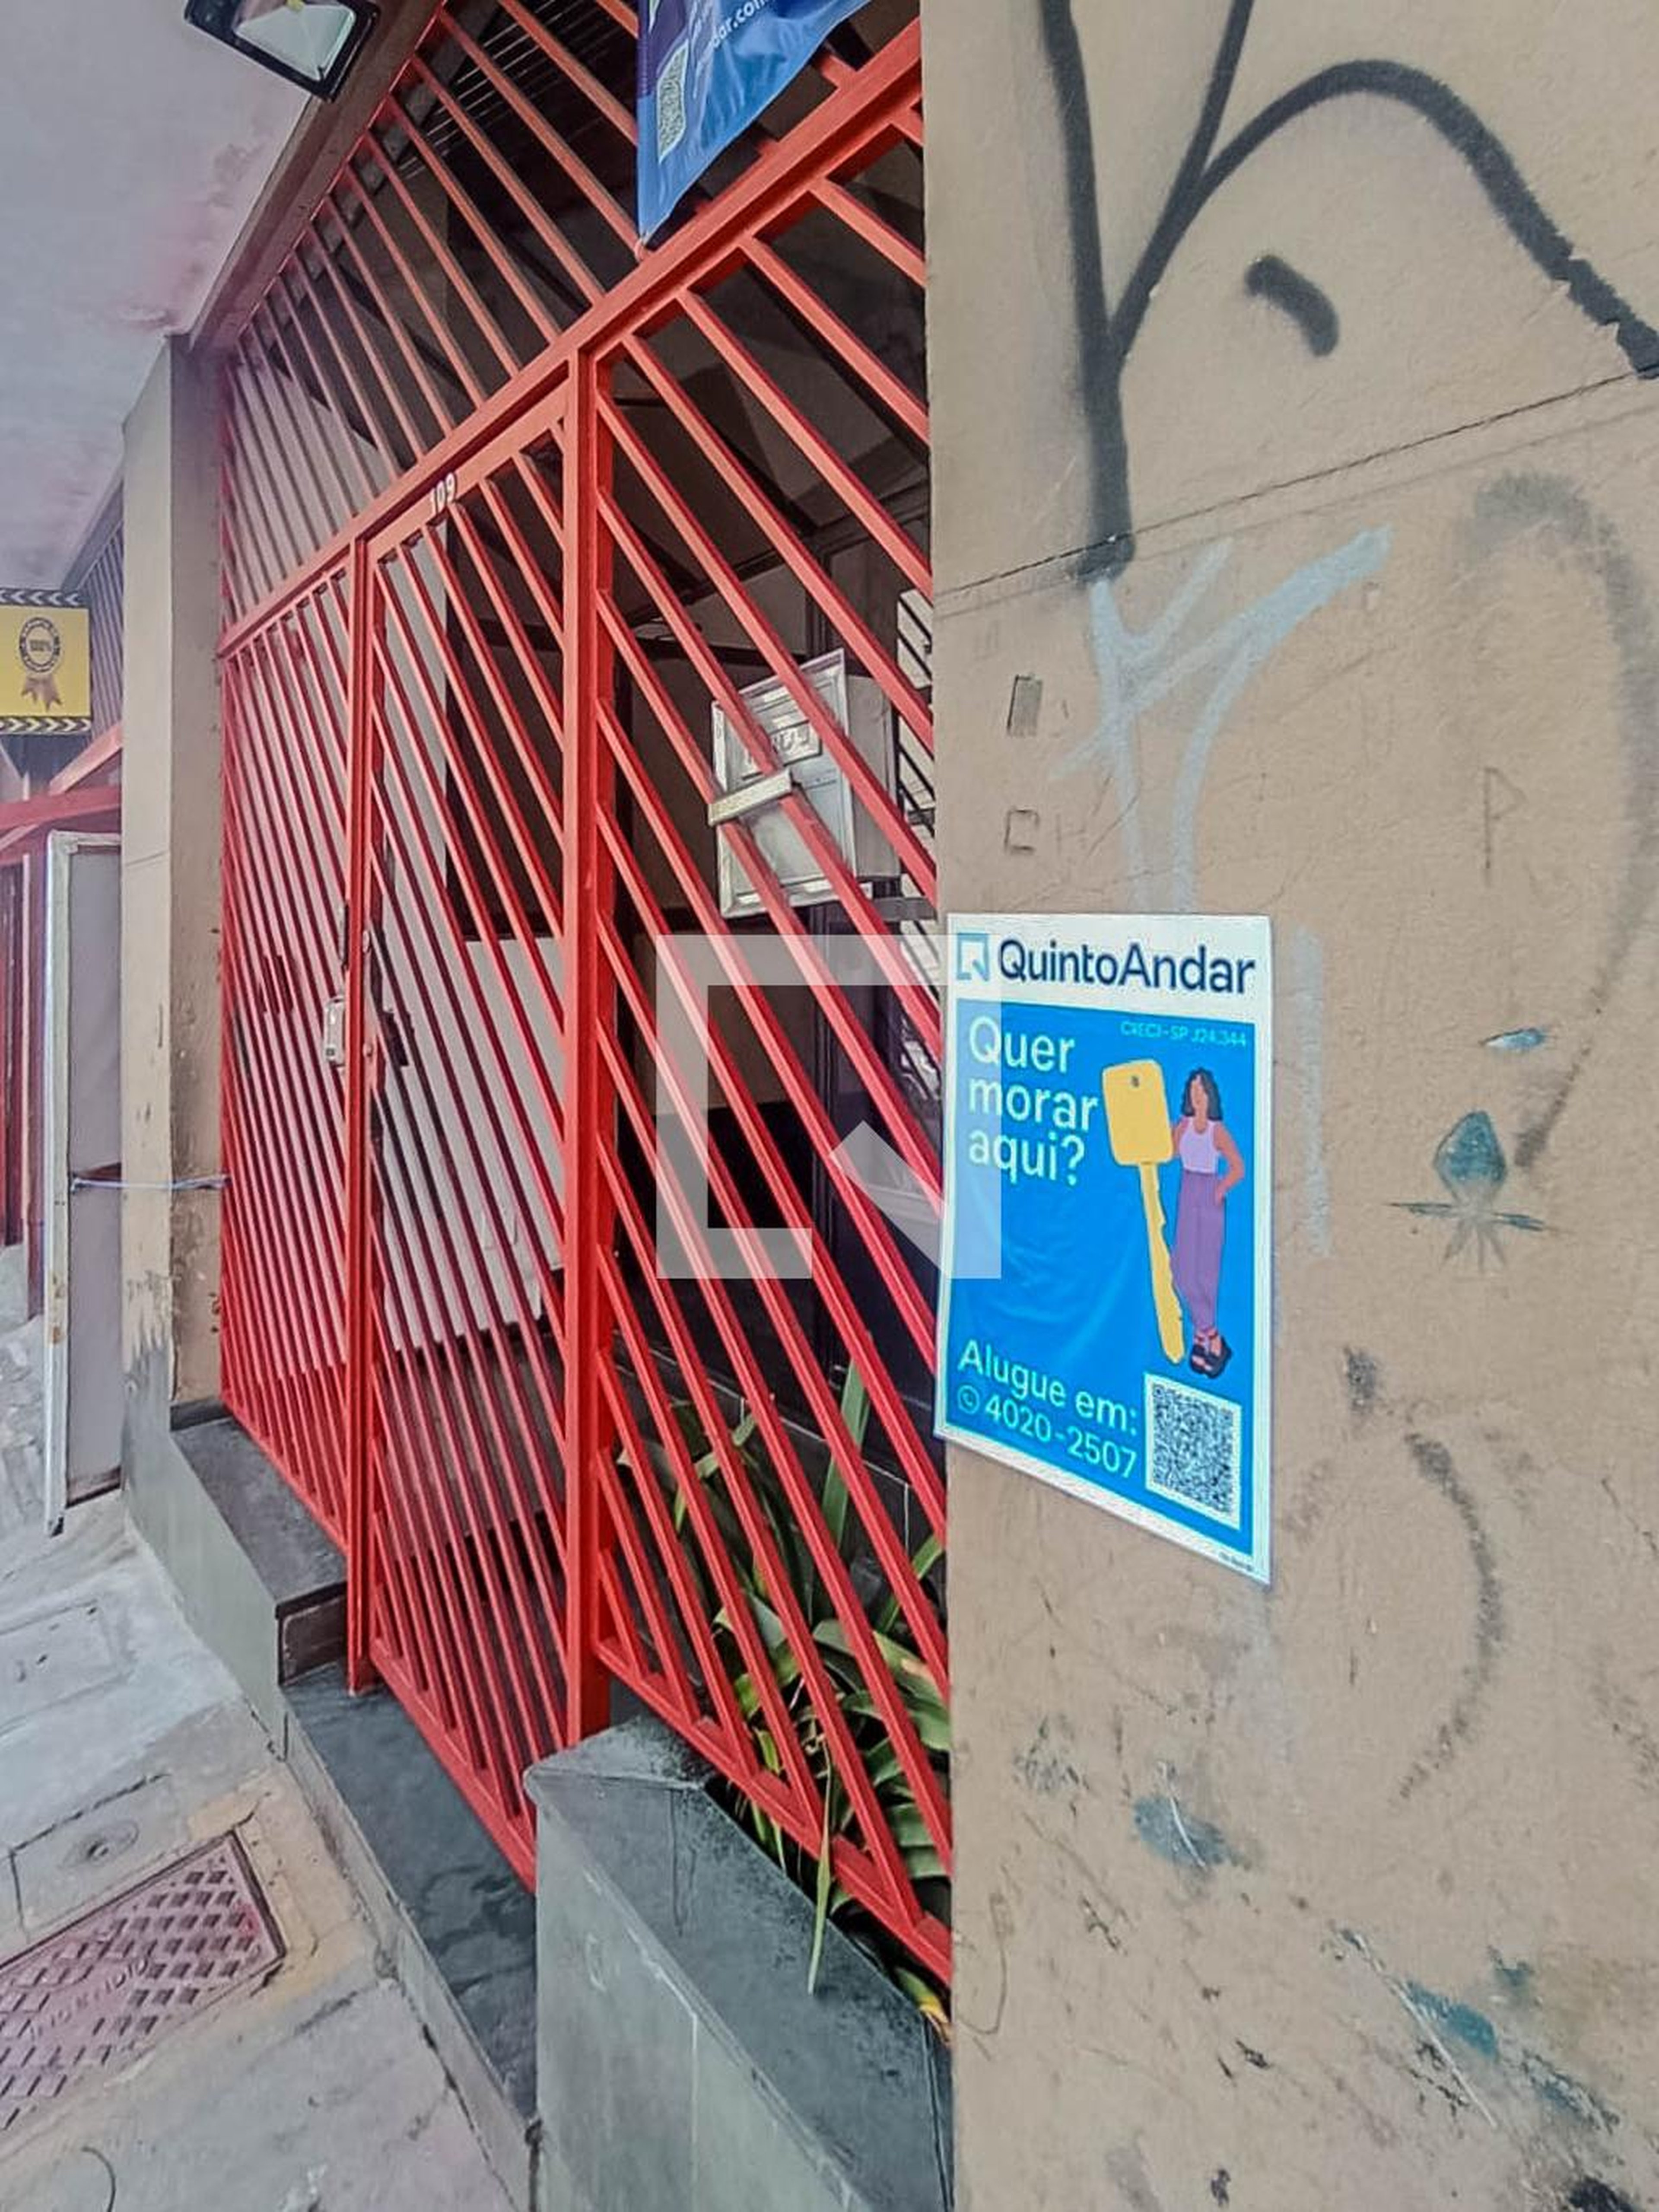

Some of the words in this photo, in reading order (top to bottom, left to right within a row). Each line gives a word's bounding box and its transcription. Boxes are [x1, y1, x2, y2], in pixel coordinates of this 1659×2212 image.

[431, 472, 455, 514] 109
[999, 939, 1255, 994] QuintoAndar
[969, 1016, 1075, 1073] Quer
[969, 1077, 1099, 1131] morar
[969, 1129, 1084, 1186] aqui?
[957, 1340, 1066, 1407] Alugue
[1076, 1390, 1137, 1435] em:
[985, 1394, 1137, 1478] 4020-2507
